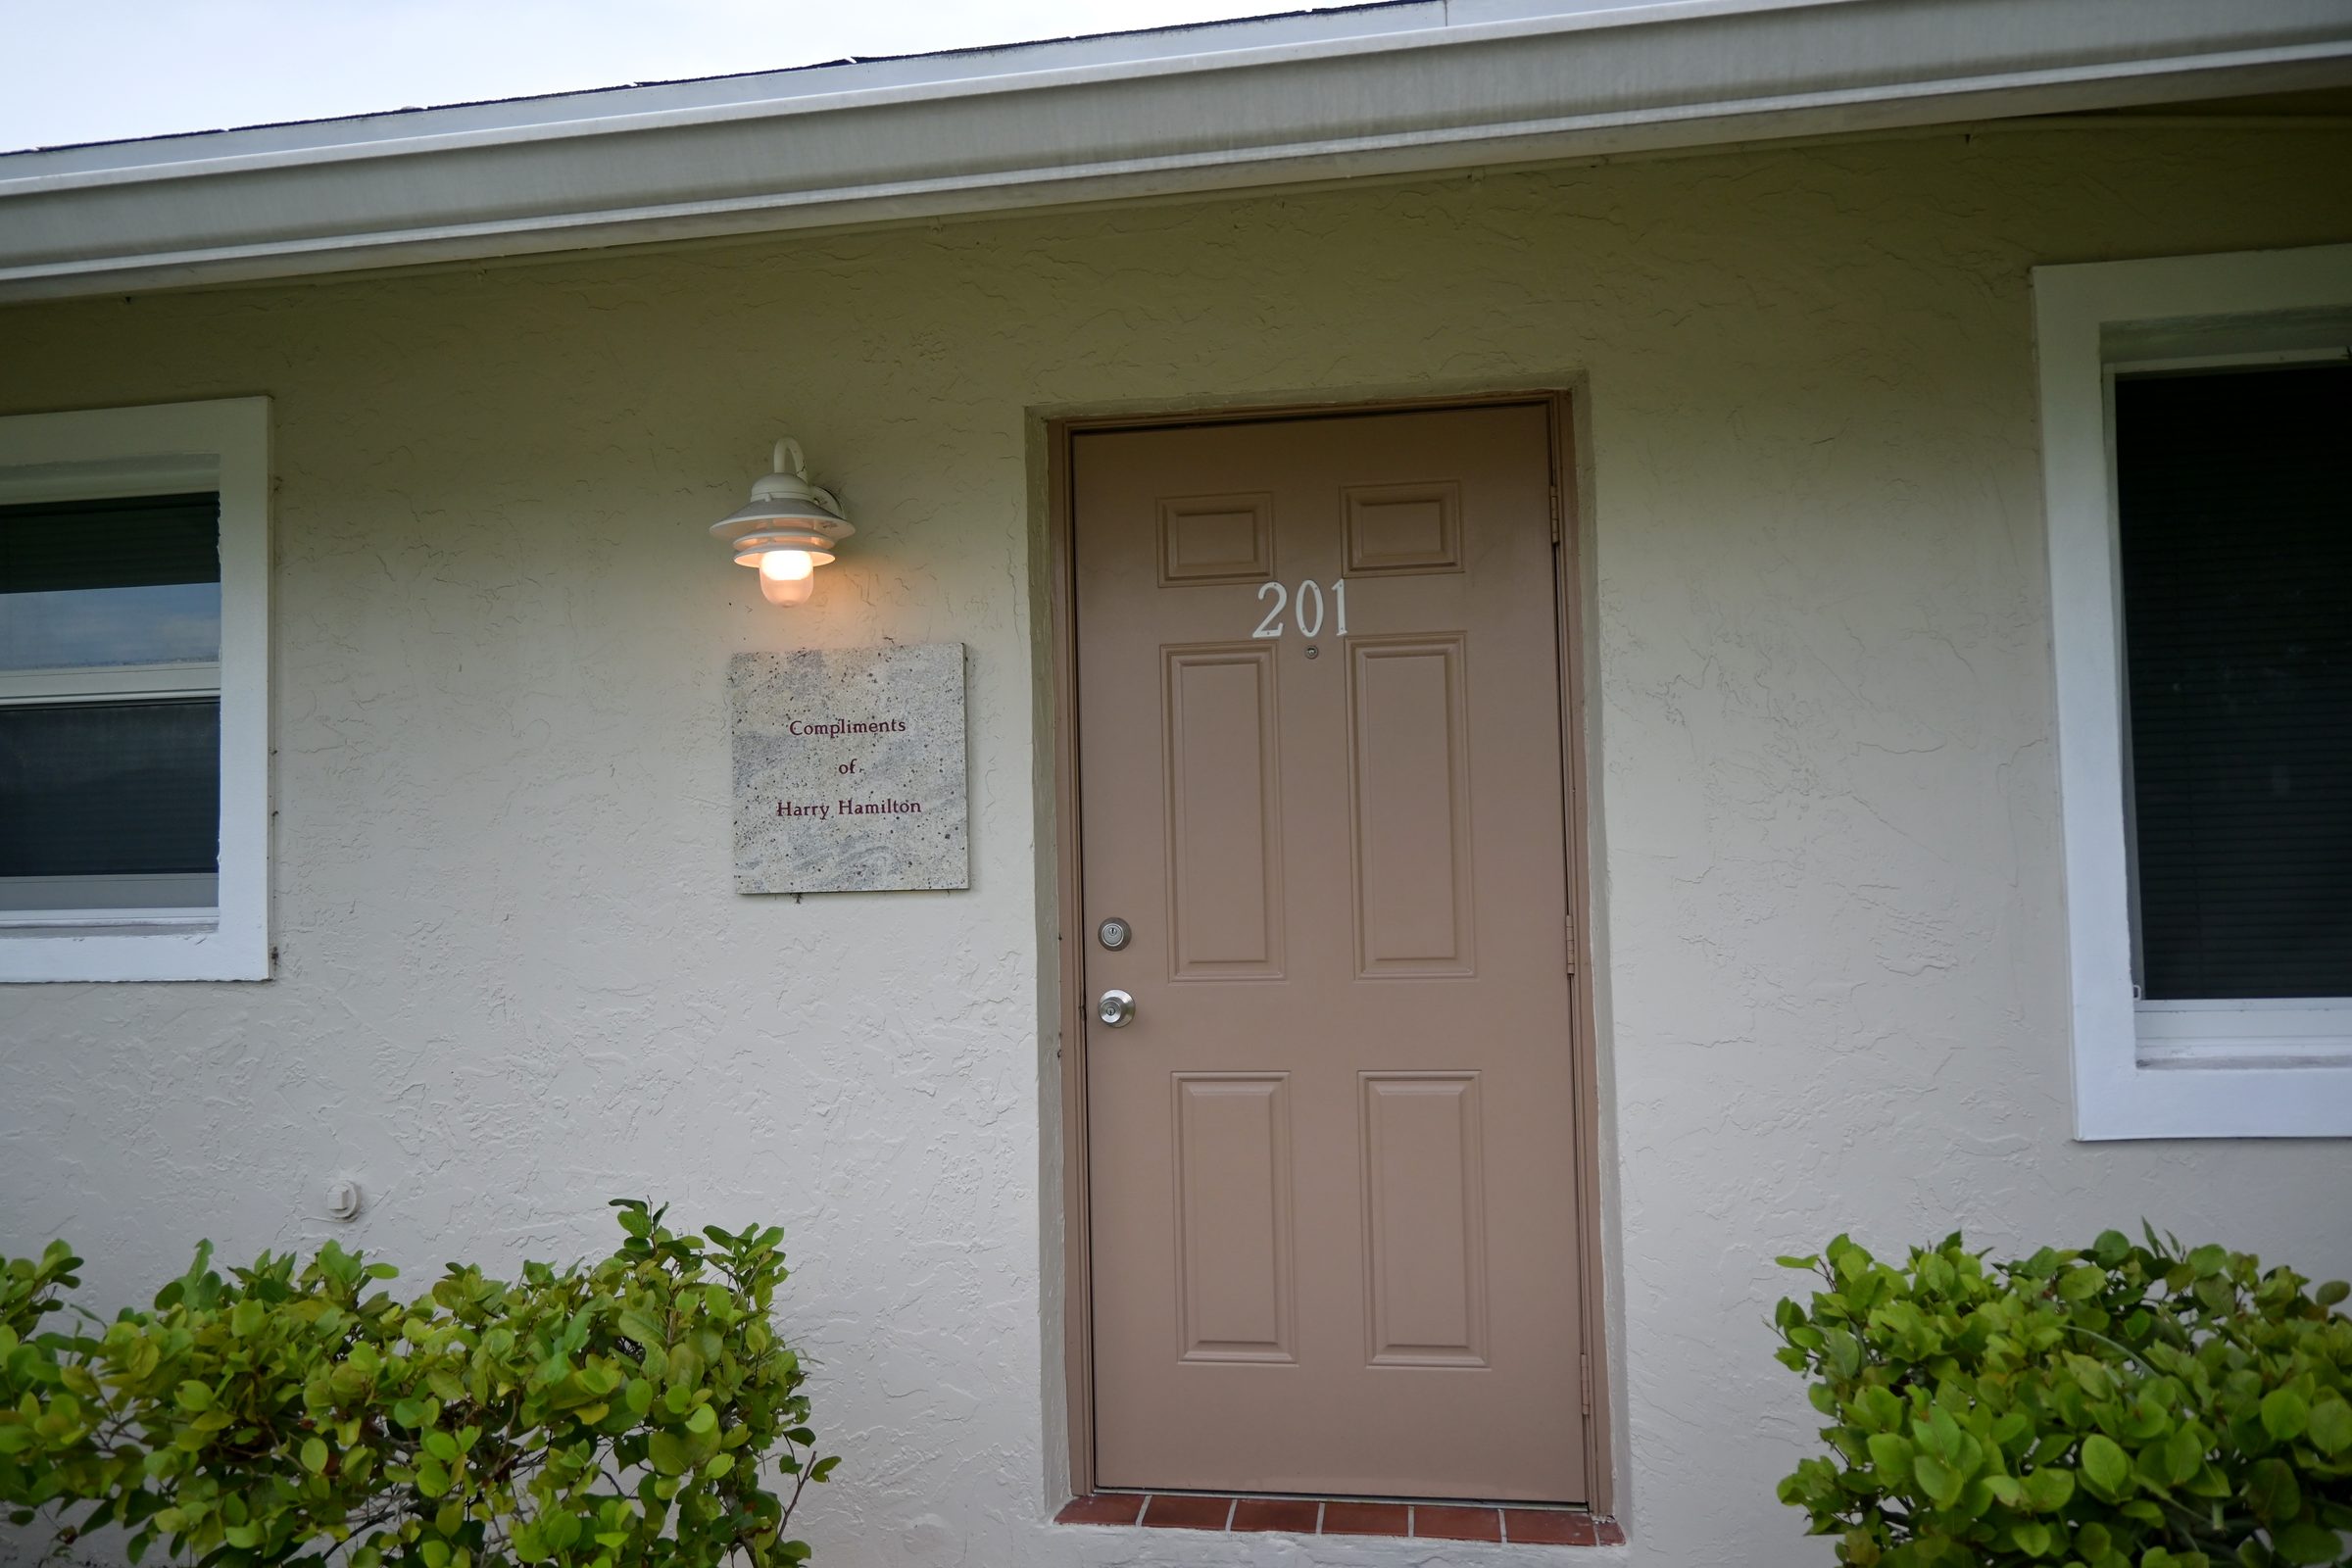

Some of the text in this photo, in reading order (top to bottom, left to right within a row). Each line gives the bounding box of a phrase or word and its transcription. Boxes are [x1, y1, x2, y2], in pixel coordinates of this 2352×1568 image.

[1252, 578, 1348, 638] 201
[789, 718, 906, 738] Compliments
[838, 759, 858, 774] of
[777, 798, 922, 820] Harry Hamilton
